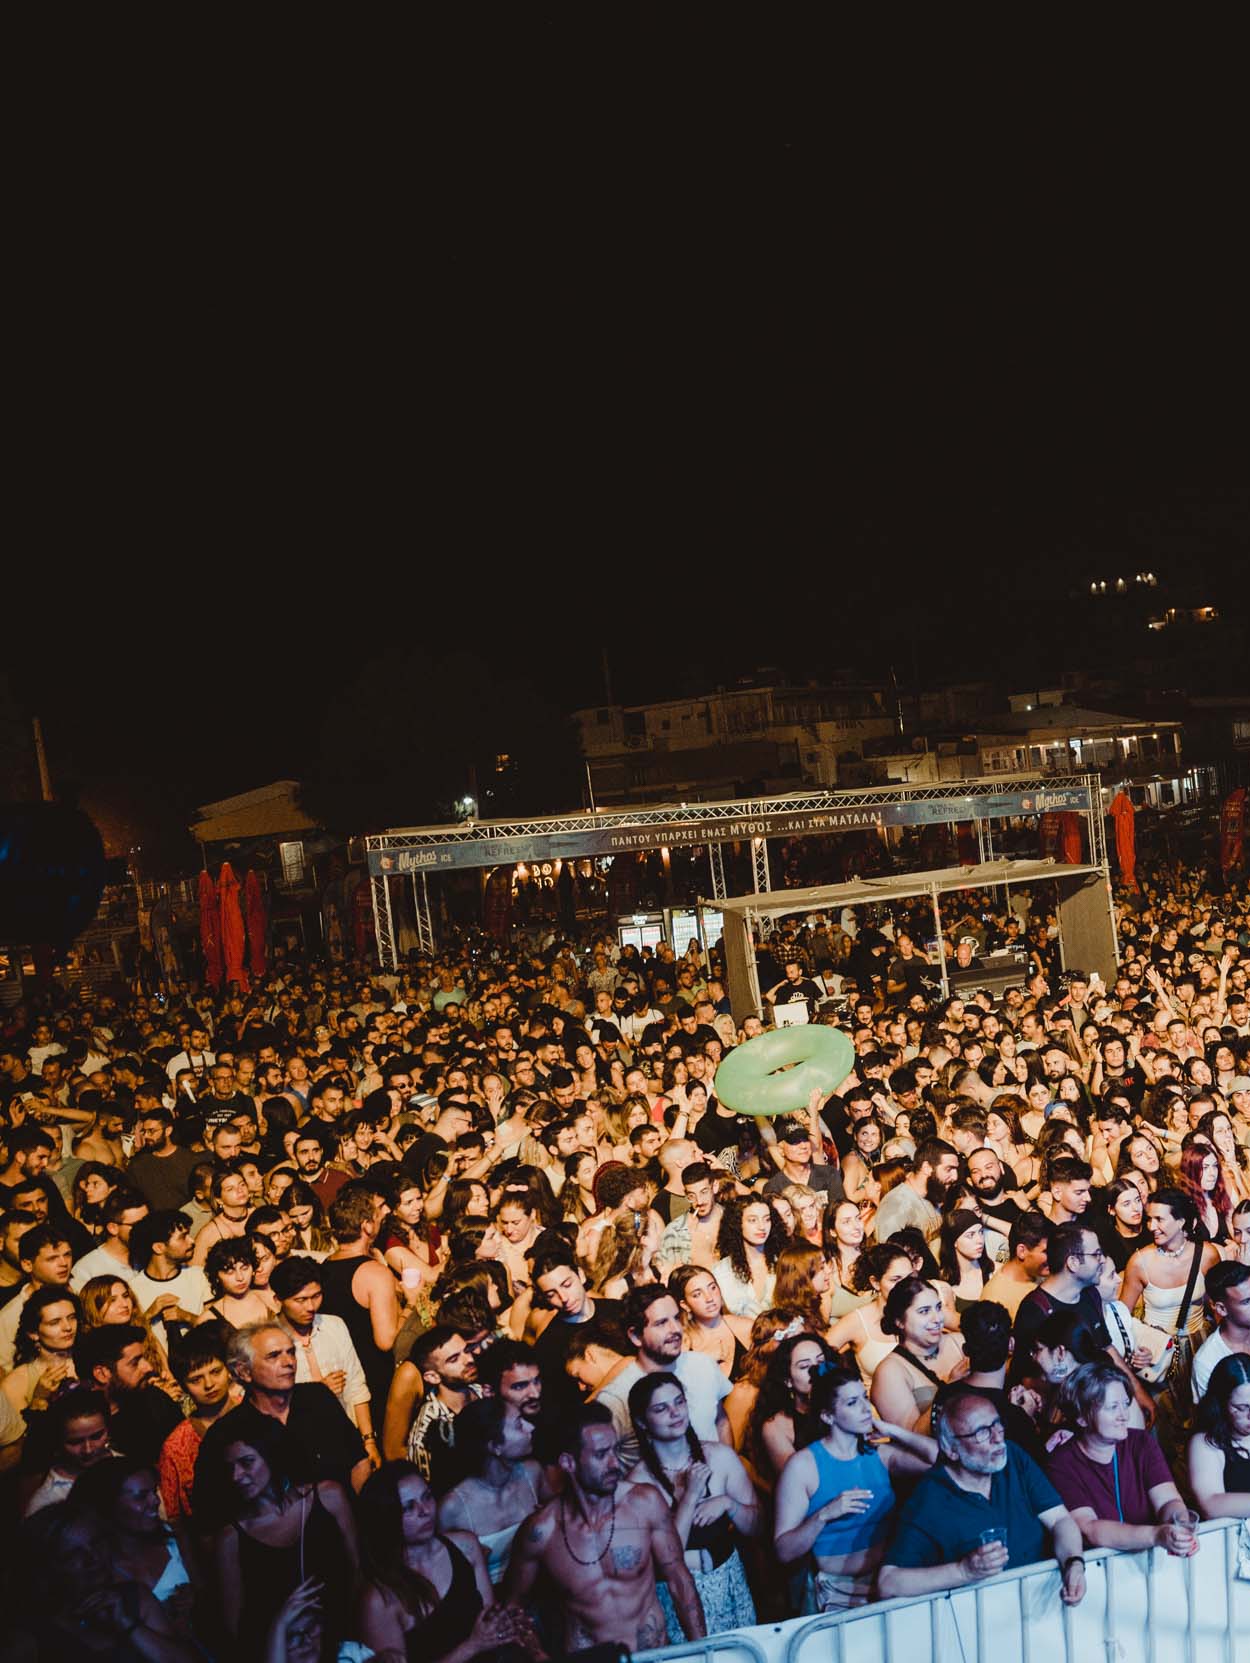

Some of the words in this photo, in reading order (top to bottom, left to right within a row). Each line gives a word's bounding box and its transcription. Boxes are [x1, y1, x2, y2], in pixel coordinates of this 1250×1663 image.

[1035, 792, 1067, 812] Mythos
[611, 834, 650, 847] ΠΑΝΤΟΥ
[655, 829, 697, 842] ΥΠΑΡΧΕΙ
[701, 827, 726, 839] ΕΝΑΣ
[730, 820, 773, 835] ΜΥΘΟΣ
[808, 819, 825, 828] ΣΤΑ
[398, 849, 438, 872] Mythos
